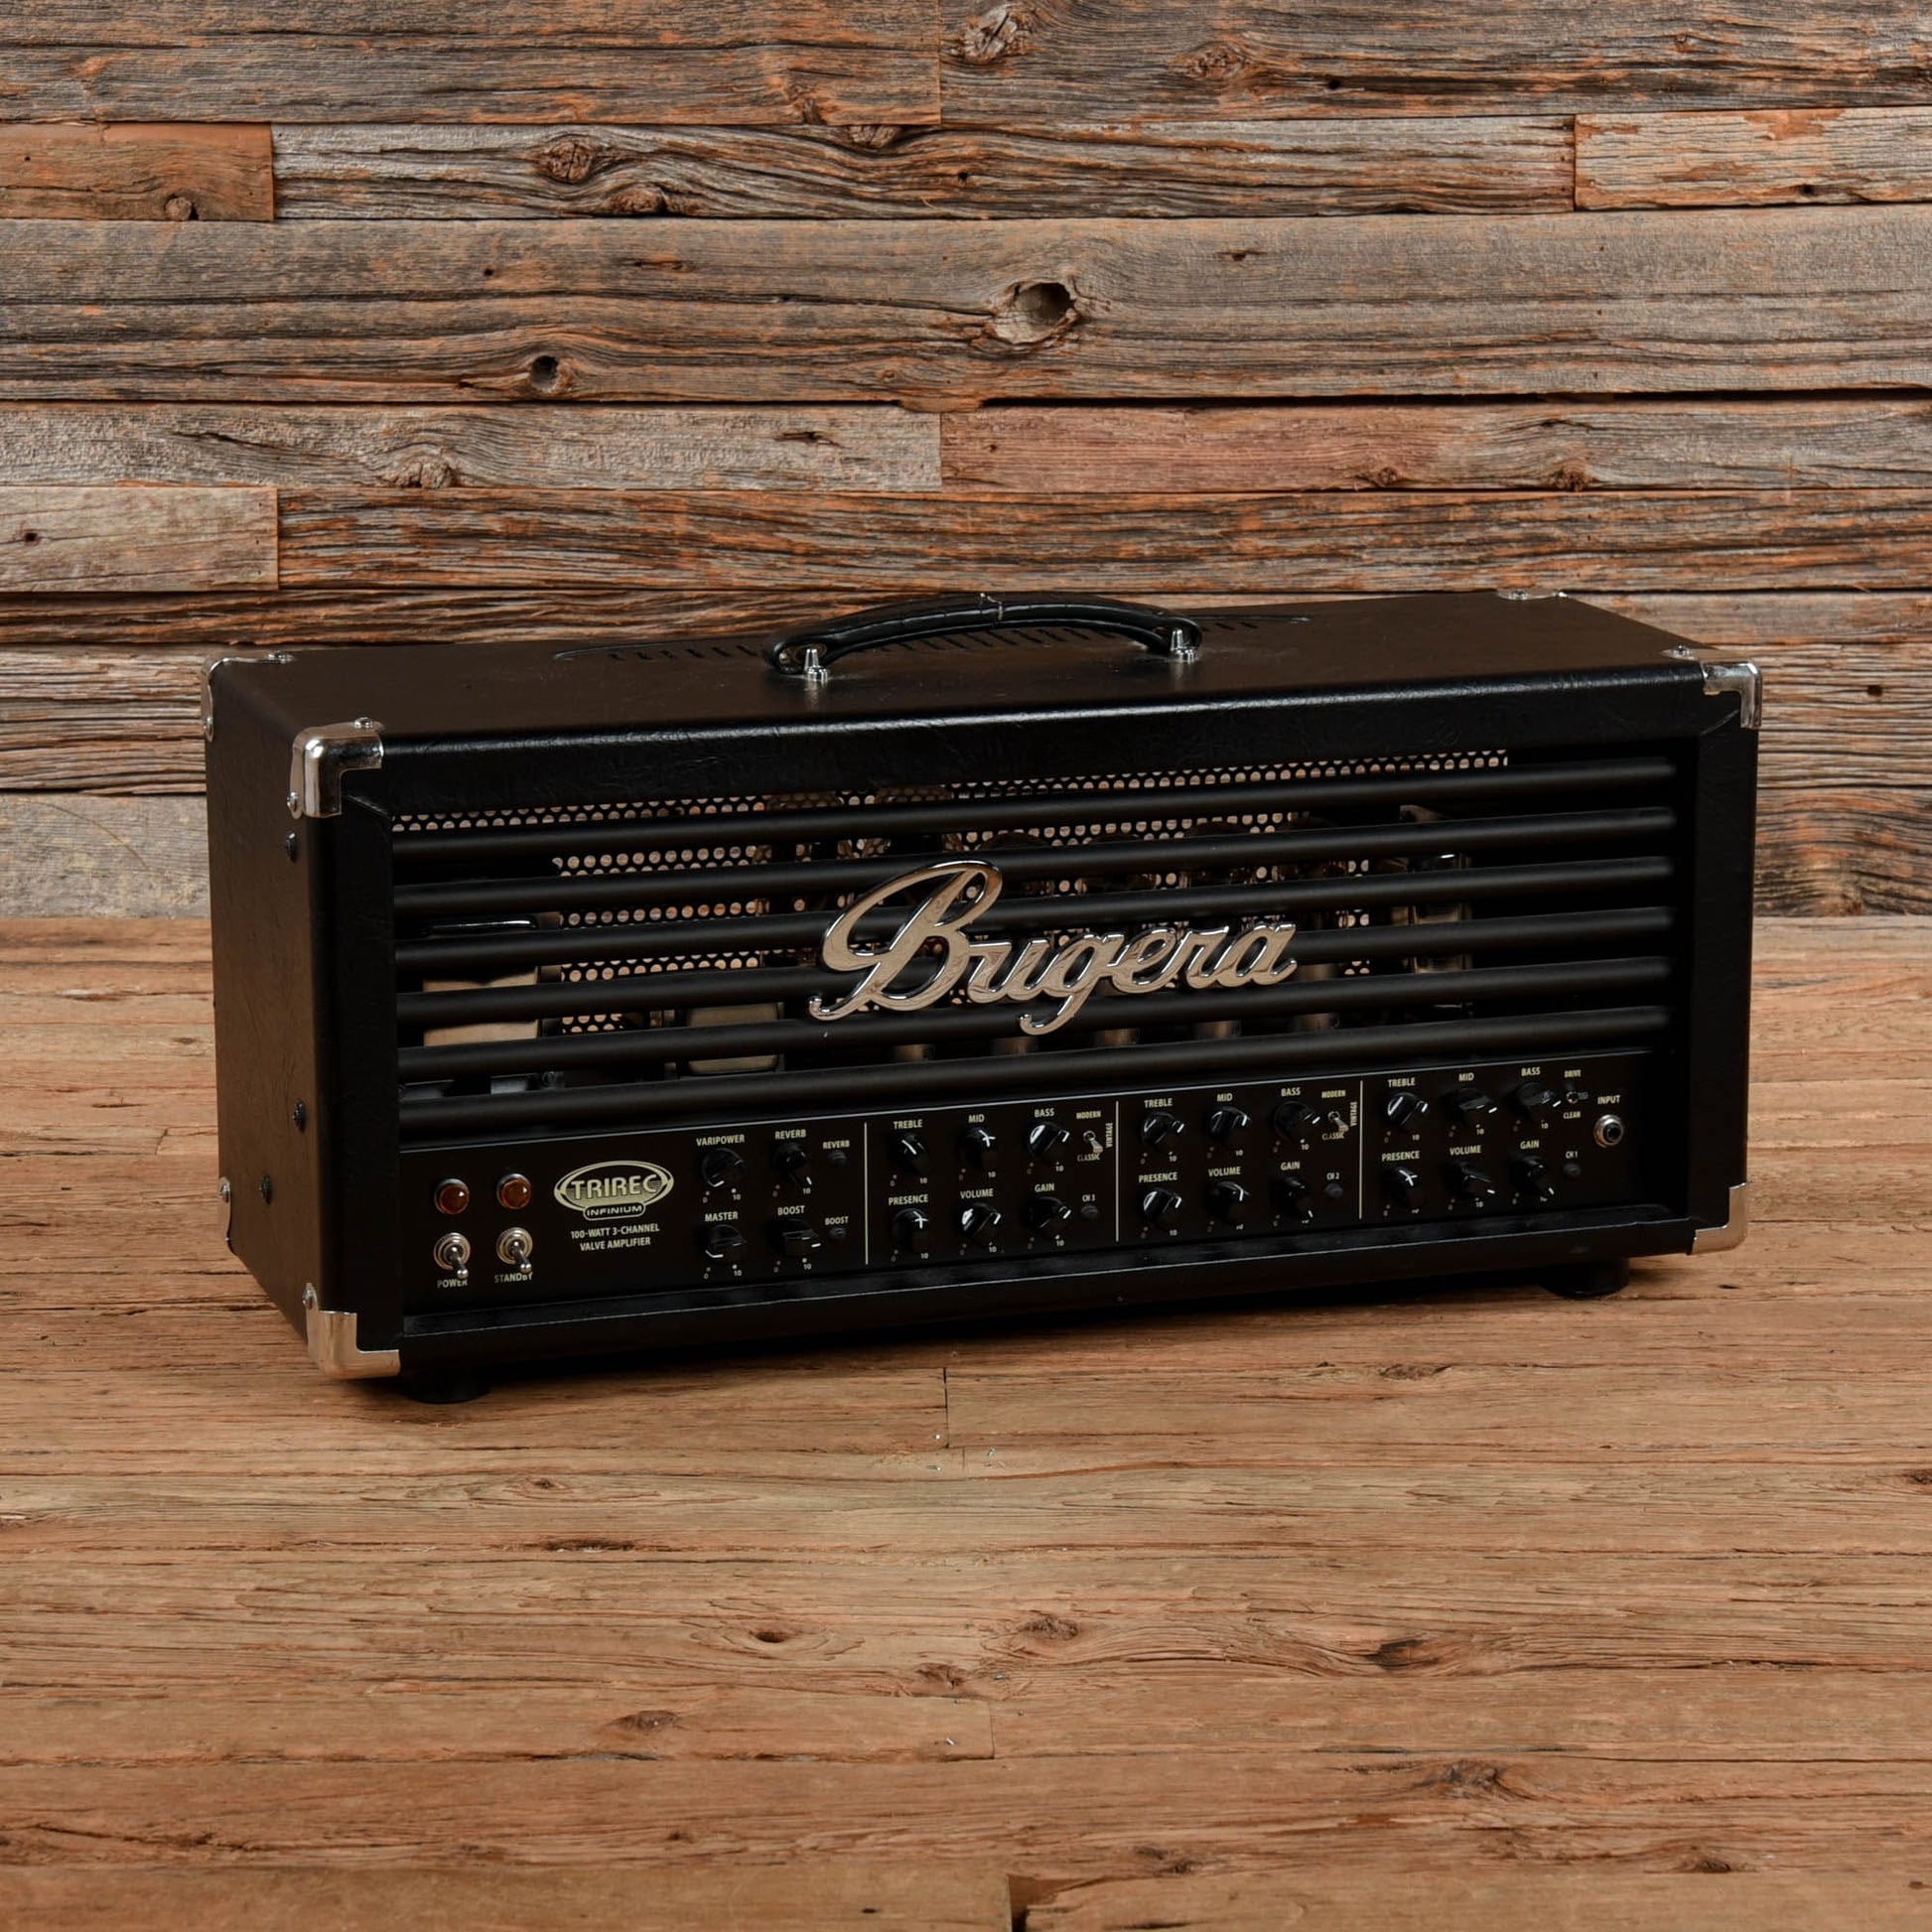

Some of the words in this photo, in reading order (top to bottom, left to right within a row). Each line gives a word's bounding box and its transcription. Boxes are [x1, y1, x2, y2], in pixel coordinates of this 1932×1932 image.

[808, 860, 1297, 1035] Bugera
[1521, 1066, 1541, 1076] BASS
[1388, 1076, 1416, 1087] TREBLE
[1458, 1072, 1474, 1082] MID
[1281, 1087, 1301, 1096] BASS
[1321, 1090, 1346, 1099] MODERN
[1216, 1093, 1232, 1102] MID
[1597, 1095, 1621, 1105] INPUT
[1144, 1098, 1173, 1108] TREBLE
[1035, 1108, 1054, 1118] BASS
[894, 1119, 922, 1130] TREBLE
[968, 1115, 985, 1124] MID
[775, 1129, 806, 1140] REVERB
[696, 1134, 746, 1147] VARIPOWER
[822, 1140, 850, 1150] REVERB
[1520, 1140, 1540, 1150] GAIN
[1382, 1150, 1421, 1162] PRESENCE
[1449, 1145, 1481, 1157] VOLUME
[1281, 1162, 1301, 1171] GAIN
[1208, 1167, 1241, 1177] VOLUME
[1139, 1172, 1178, 1183] PRESENCE
[570, 1173, 660, 1201] TRIREC
[1035, 1183, 1054, 1192] GAIN
[960, 1188, 994, 1199] VOLUME
[889, 1194, 928, 1206] PRESENCE
[587, 1205, 642, 1216] INFINIUM
[777, 1205, 805, 1215] BOOST
[705, 1211, 739, 1222] MASTER
[825, 1216, 849, 1225] BOOST
[570, 1227, 611, 1239] 100-WATT
[613, 1223, 660, 1236] 3-CHANNEL
[580, 1241, 606, 1251] VALVE
[608, 1237, 651, 1249] AMPLIFIER
